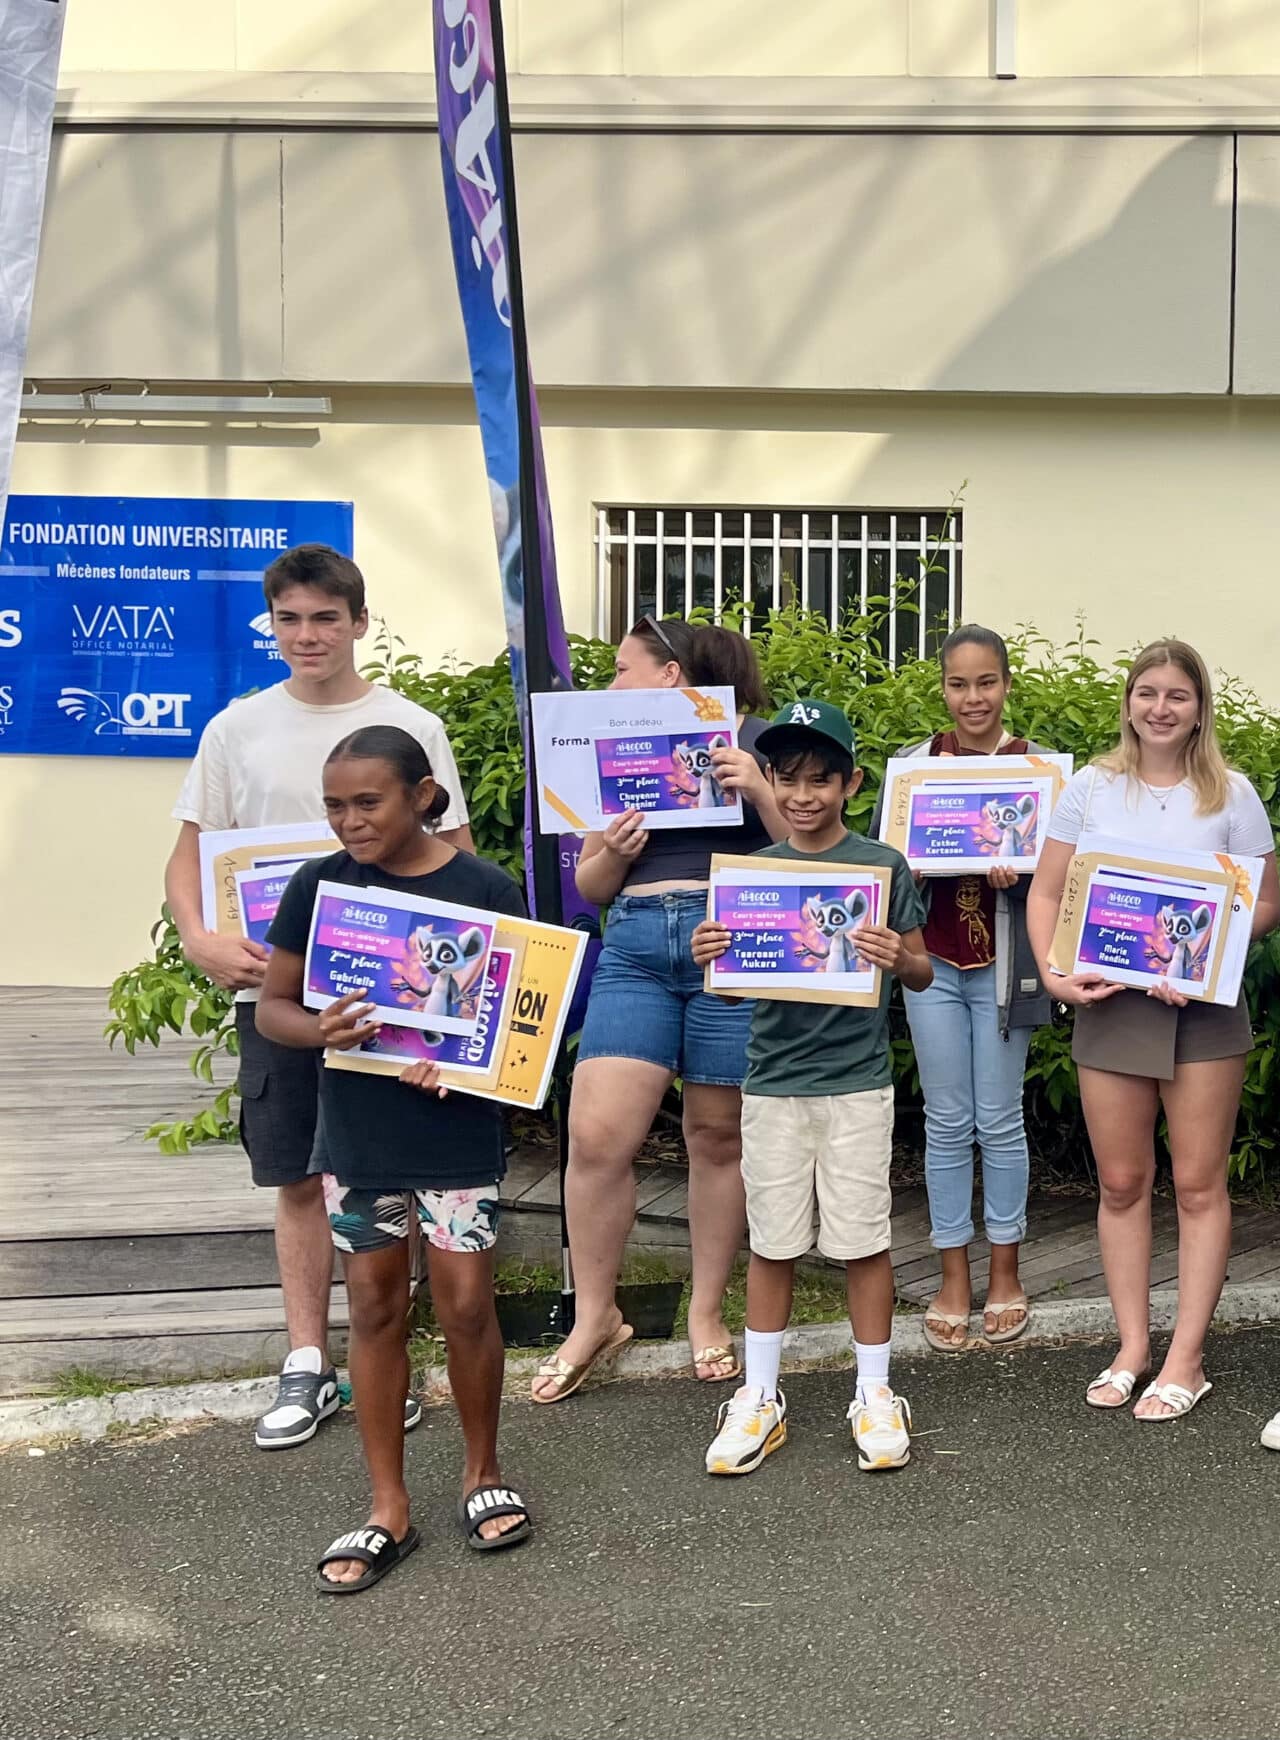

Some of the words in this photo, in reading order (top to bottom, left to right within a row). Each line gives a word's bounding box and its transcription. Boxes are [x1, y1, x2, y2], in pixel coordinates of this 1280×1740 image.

[9, 522, 126, 546] FONDATION
[132, 525, 288, 549] UNIVERSITAIRE
[56, 563, 116, 579] Mécènes
[120, 564, 191, 581] fondateurs
[72, 641, 112, 649] OFFICE
[118, 641, 175, 651] NOTARIAL
[122, 692, 191, 728] OPT
[609, 719, 628, 728] Bon
[551, 736, 591, 747] Forma
[512, 986, 549, 1022] ION
[468, 1489, 525, 1519] NIKE
[324, 1529, 388, 1555] NIKE
